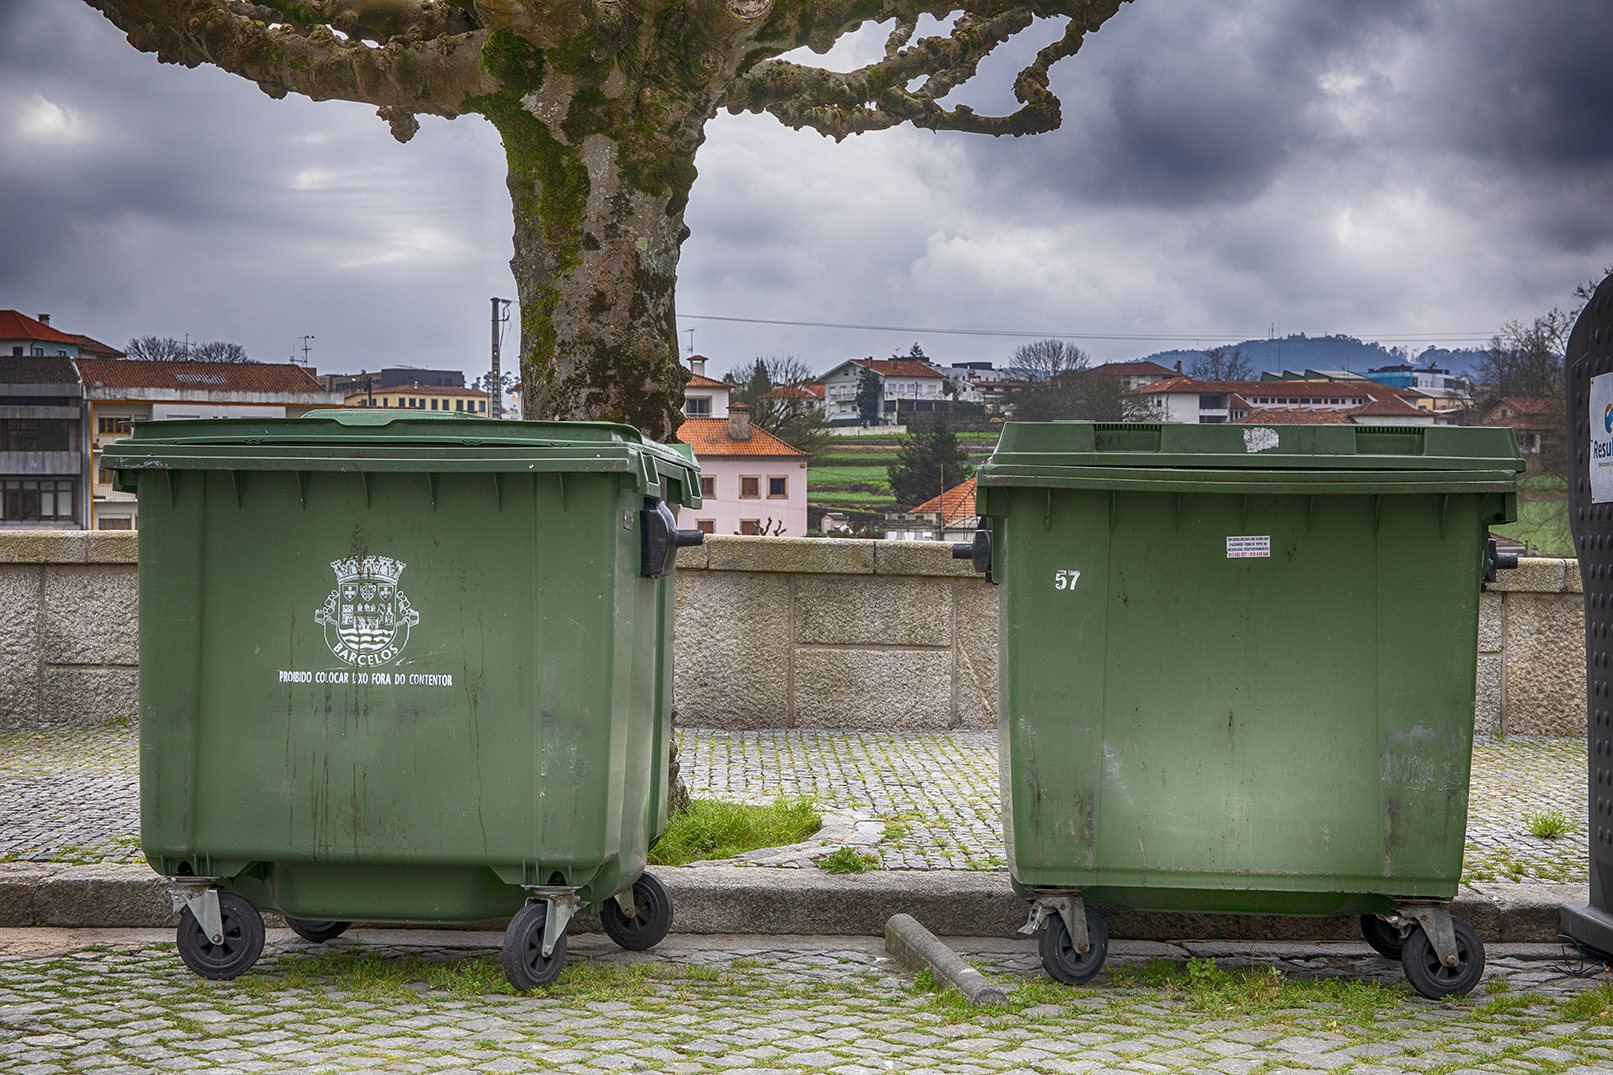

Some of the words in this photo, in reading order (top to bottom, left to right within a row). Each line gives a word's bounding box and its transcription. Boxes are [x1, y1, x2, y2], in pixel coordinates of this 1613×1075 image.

[1055, 569, 1080, 590] 57
[333, 642, 398, 665] BARCELOS
[279, 670, 312, 683] PROIBIDO
[315, 671, 349, 684] COLOCAR
[352, 672, 368, 684] LXO
[371, 672, 391, 685] FORA
[394, 673, 405, 685] DO
[409, 674, 452, 686] CONTENTOR
